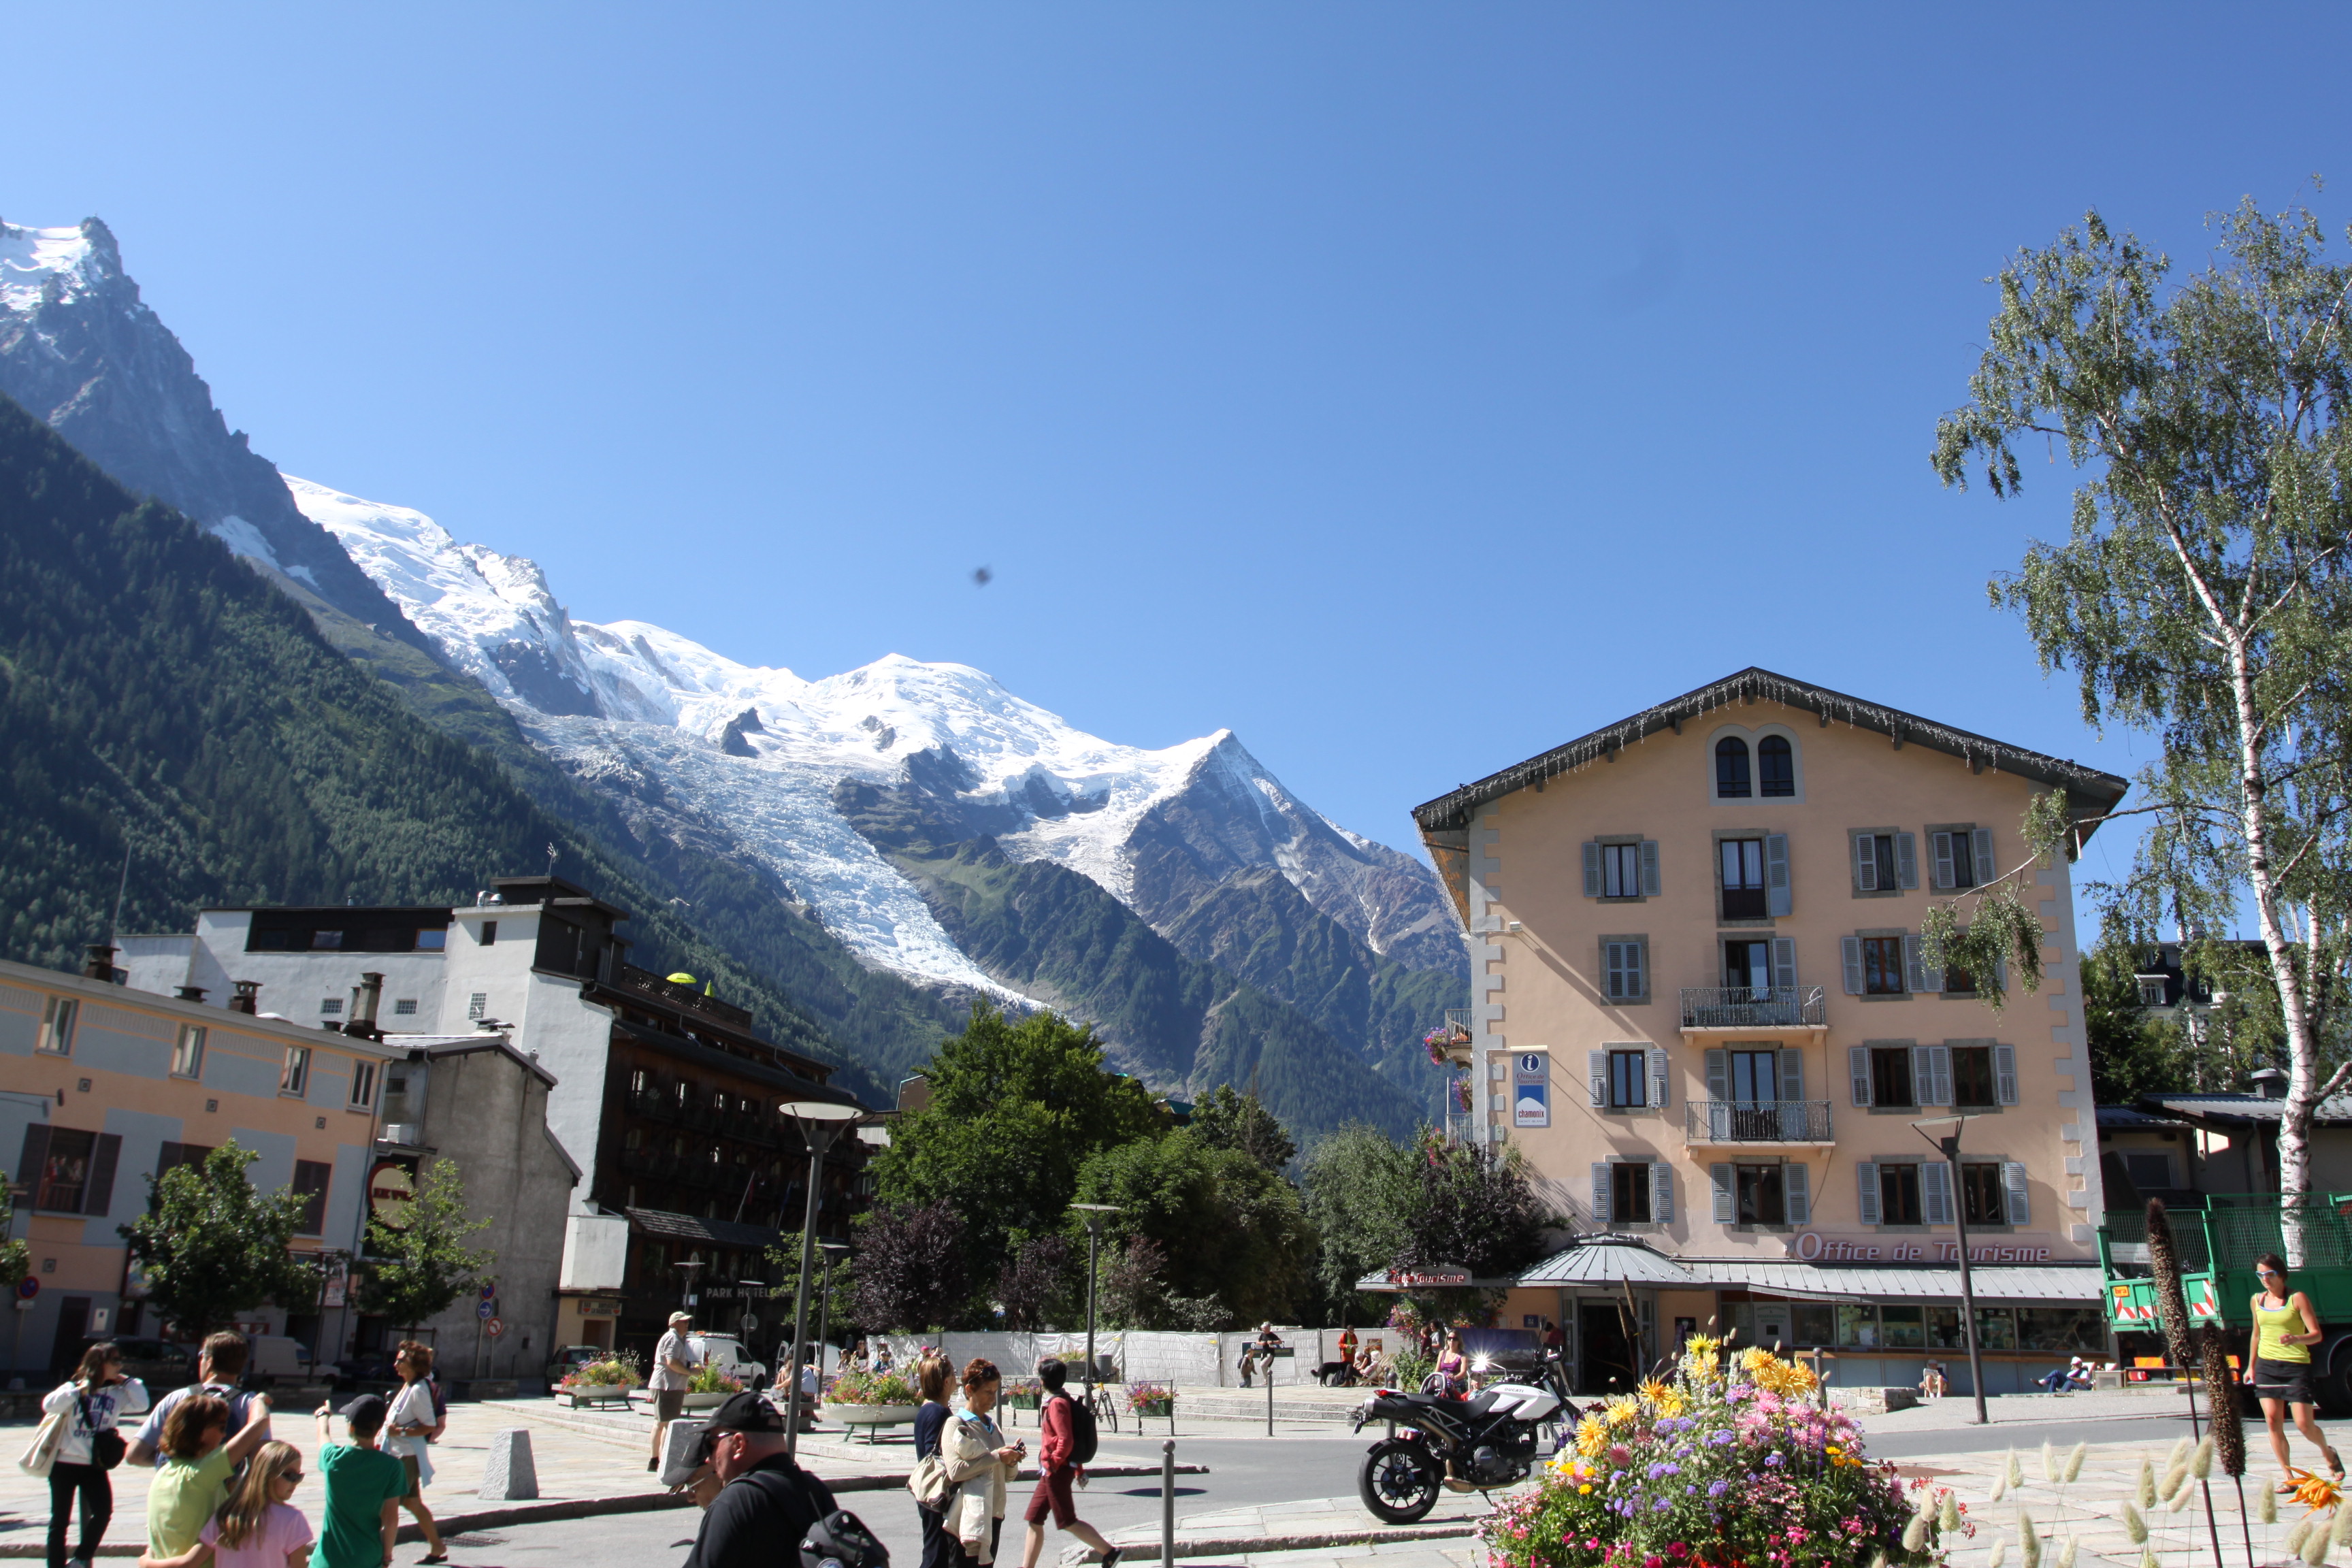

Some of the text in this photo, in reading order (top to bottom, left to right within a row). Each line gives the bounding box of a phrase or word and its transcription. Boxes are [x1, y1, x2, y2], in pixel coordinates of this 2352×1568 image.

[1518, 1109, 1544, 1117] chamonix
[1796, 1232, 2050, 1261] Office de Tourisme
[706, 1288, 732, 1298] PARK
